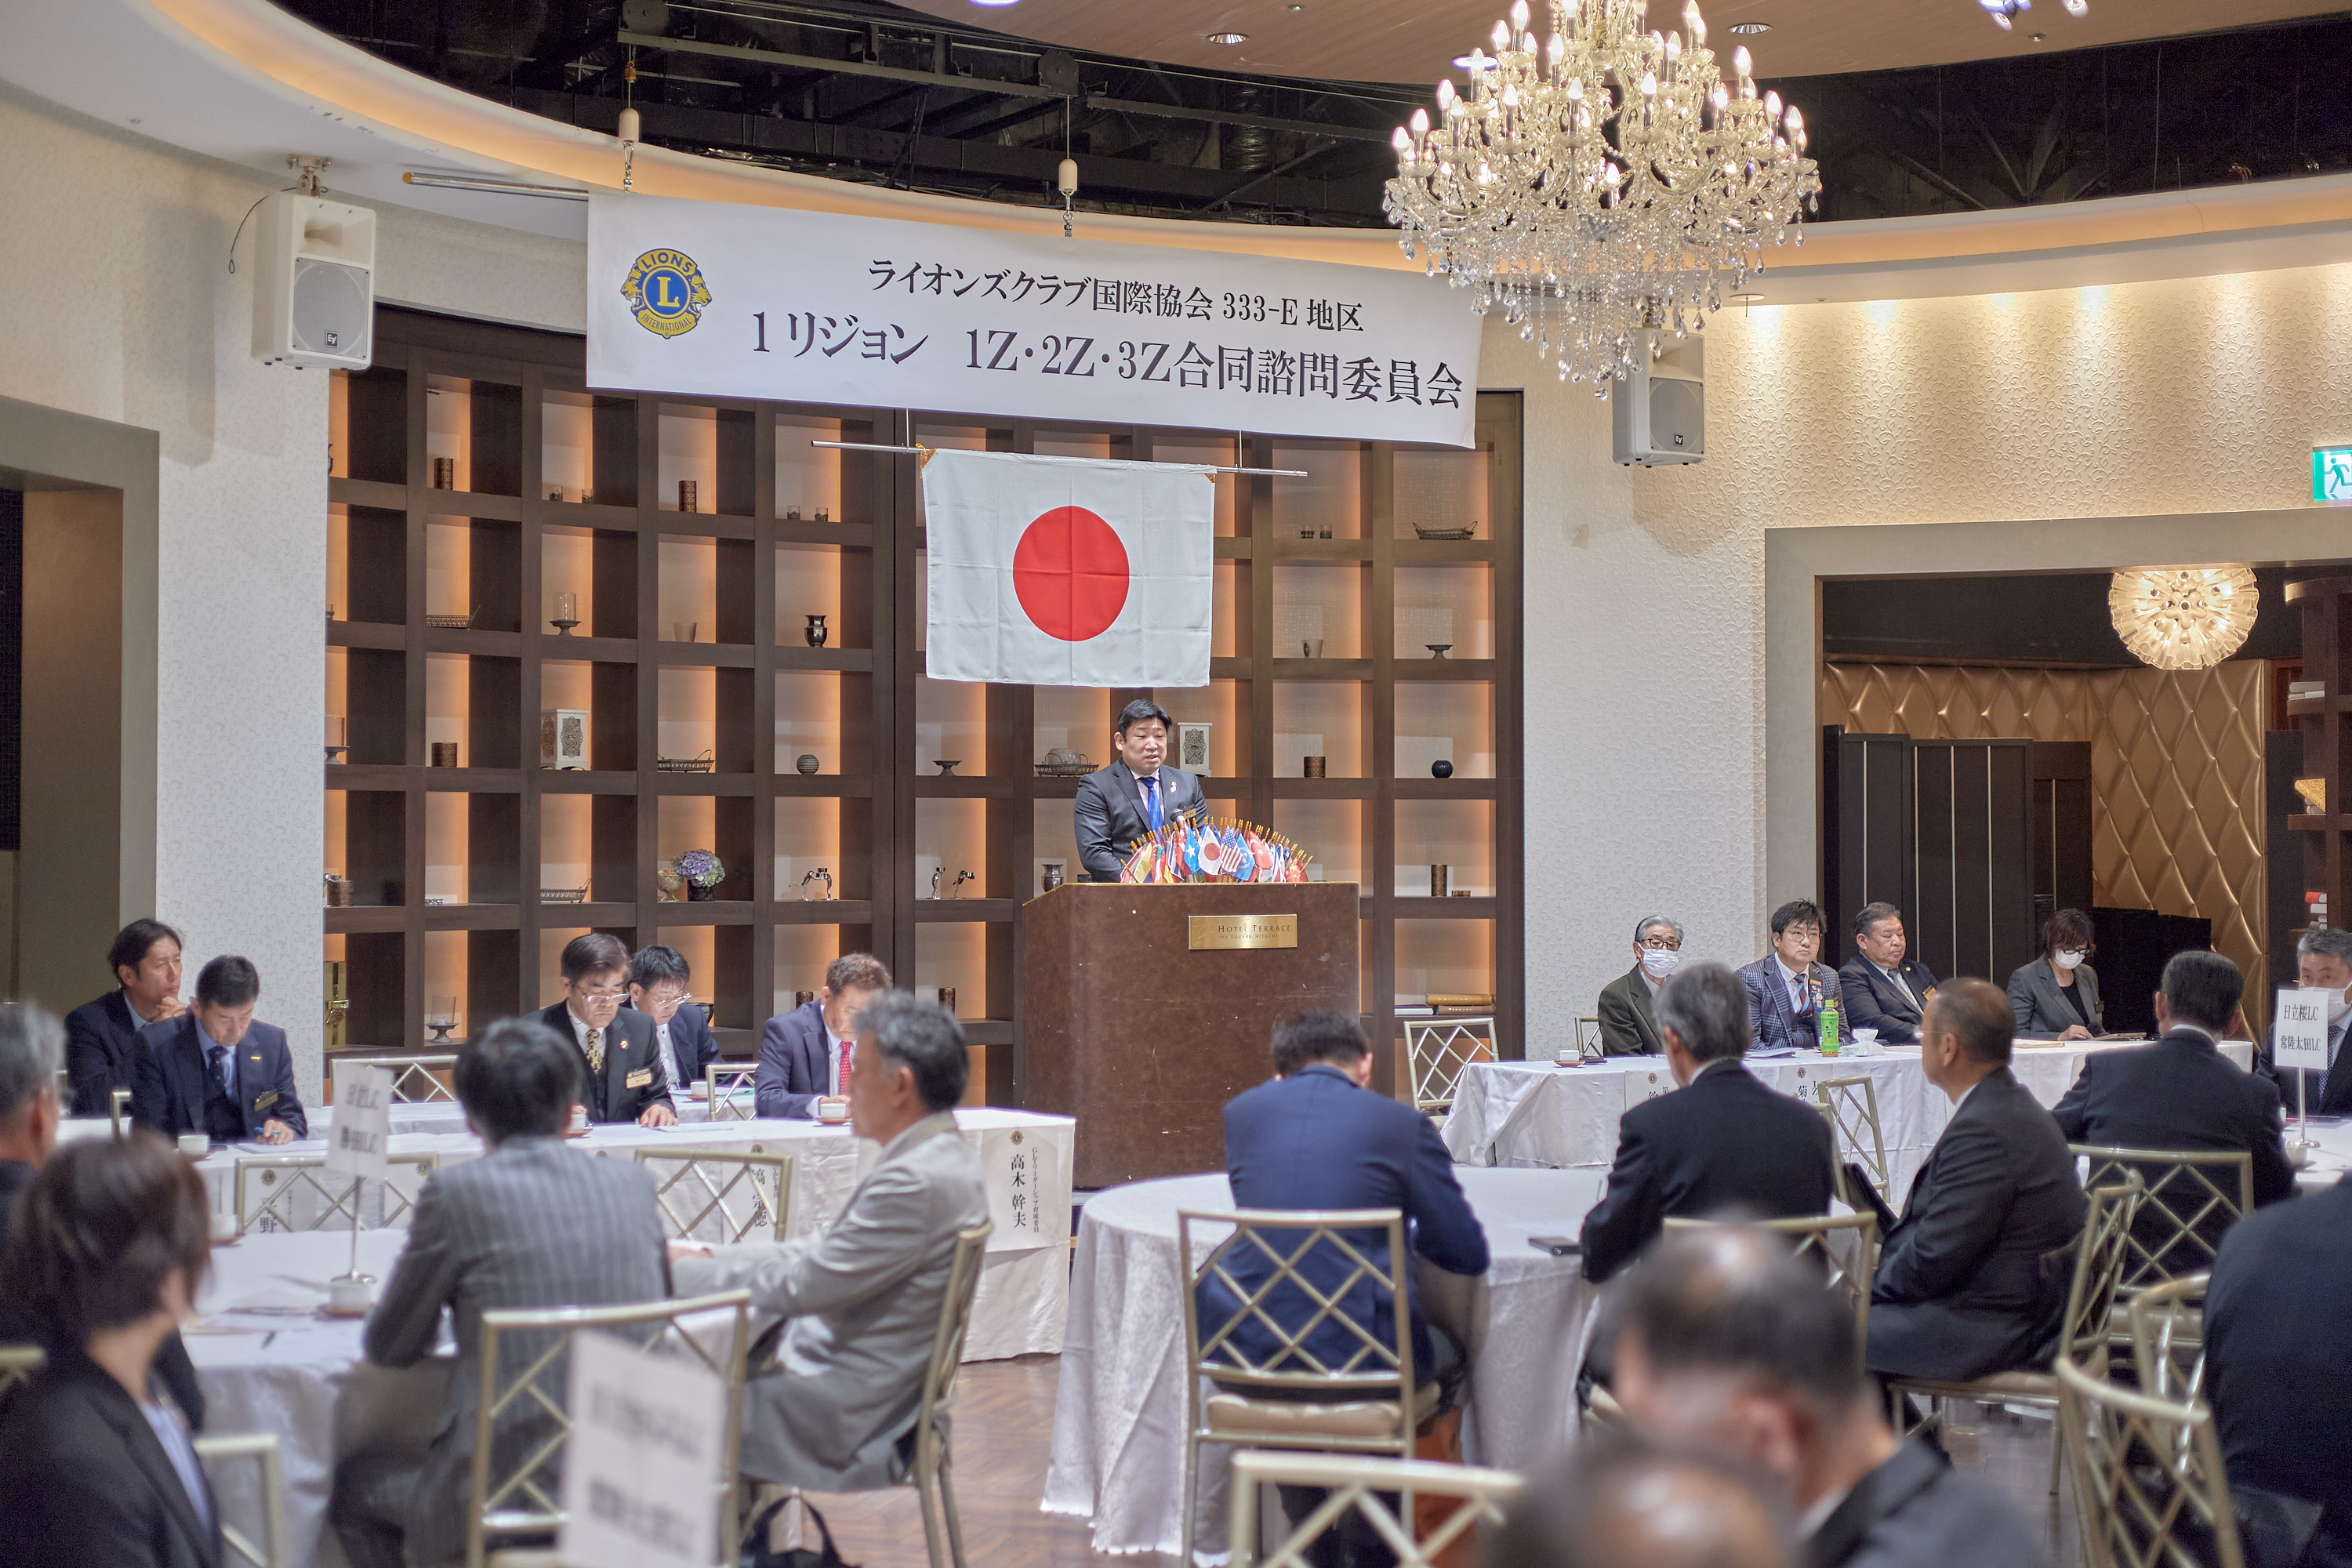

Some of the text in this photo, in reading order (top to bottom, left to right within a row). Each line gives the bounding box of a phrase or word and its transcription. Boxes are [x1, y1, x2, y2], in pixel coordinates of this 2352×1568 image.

[641, 252, 693, 274] LIONS
[657, 276, 680, 307] L
[869, 259, 1364, 332] ライオンズクラブ国際協会 333-E 地区
[641, 313, 693, 332] INTERNATIONAL
[2284, 1004, 2319, 1022] 日立桜LC
[2280, 1035, 2321, 1051] 常陸太田LC
[1011, 1153, 1027, 1229] 高木 幹夫
